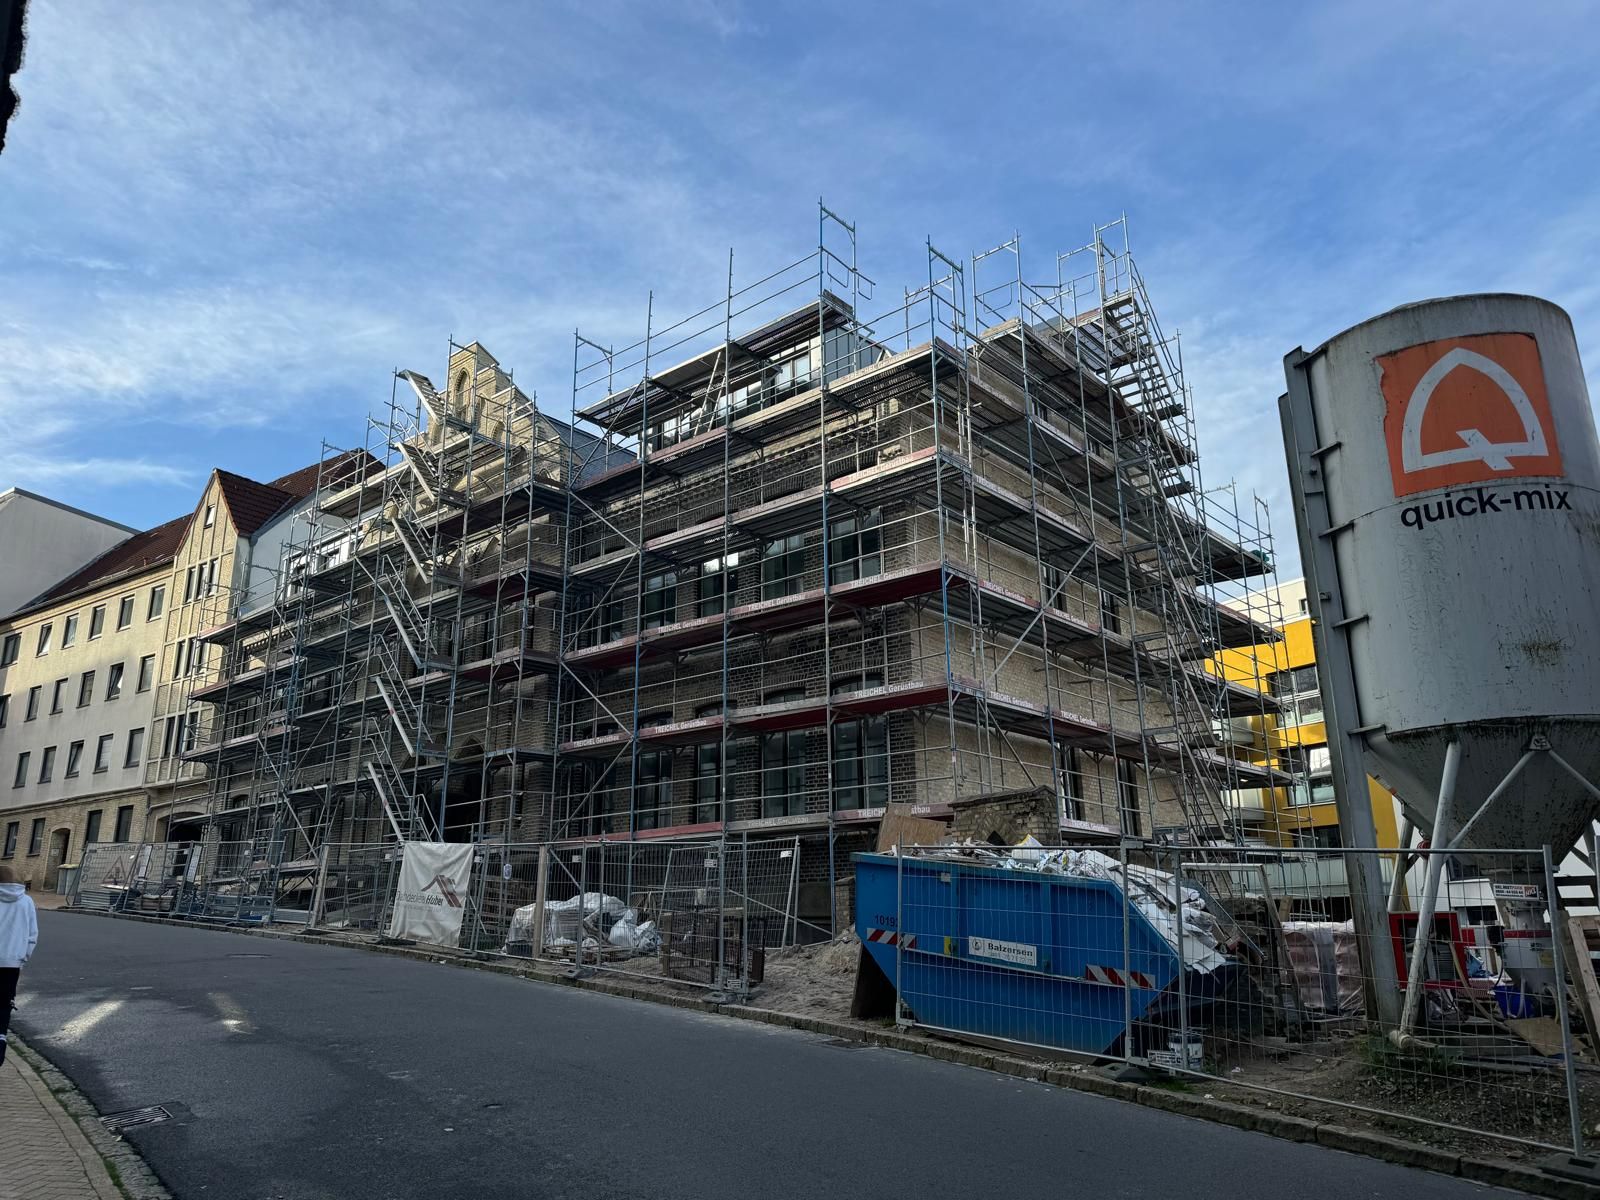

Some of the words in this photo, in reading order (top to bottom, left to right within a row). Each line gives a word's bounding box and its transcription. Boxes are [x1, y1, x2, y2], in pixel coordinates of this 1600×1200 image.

[1400, 484, 1572, 531] quick-mix
[851, 574, 883, 588] TREICHEL
[748, 599, 776, 612] TREICHEL
[658, 623, 682, 634] TREICHEL
[854, 685, 887, 699] TREICHEL
[888, 680, 924, 693] Gerüstbau
[655, 723, 680, 734] TREICHEL
[573, 737, 596, 747] TREICHEL
[426, 895, 443, 906] Huber
